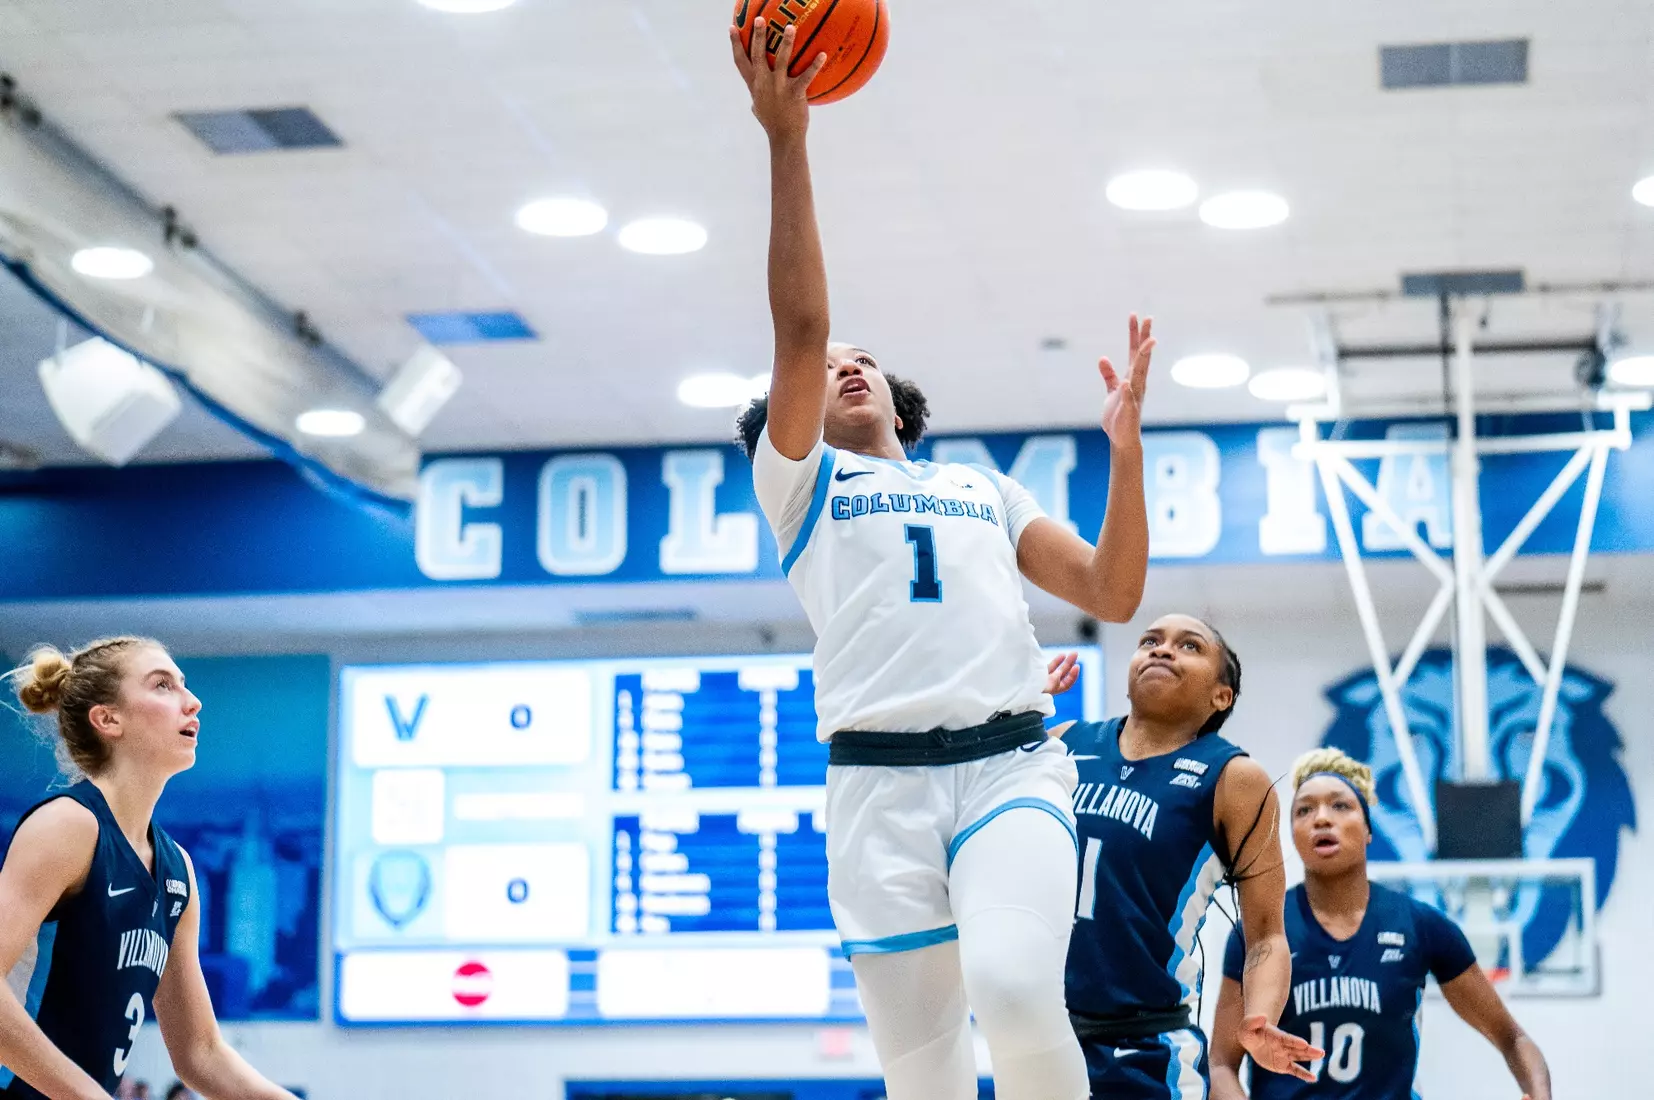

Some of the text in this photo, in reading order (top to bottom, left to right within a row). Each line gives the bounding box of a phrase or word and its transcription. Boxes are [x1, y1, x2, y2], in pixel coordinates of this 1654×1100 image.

[831, 492, 999, 526] COLUMBIA
[904, 523, 942, 603] 1
[1293, 976, 1381, 1016] VILLANOVA
[113, 992, 145, 1077] 3
[1309, 1021, 1365, 1084] 10
